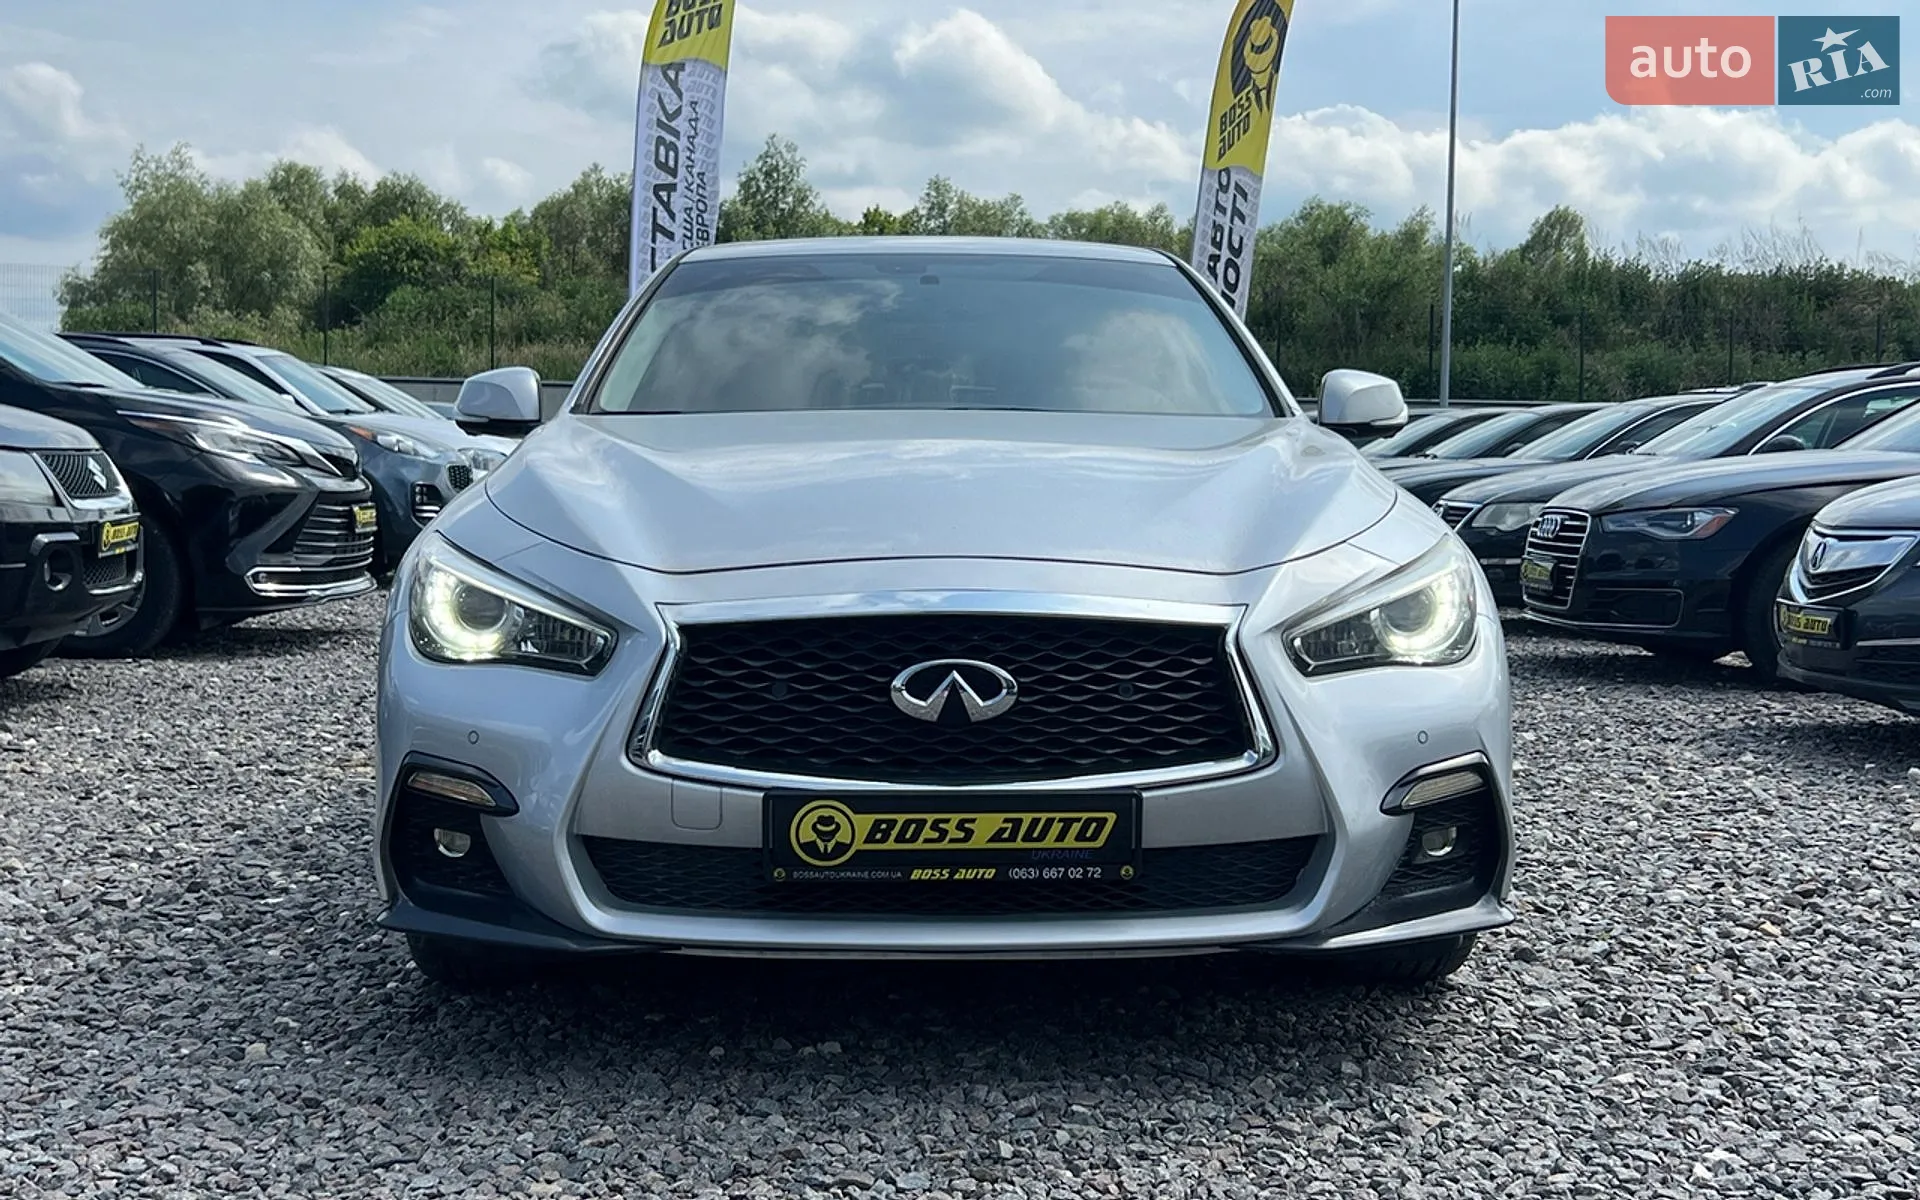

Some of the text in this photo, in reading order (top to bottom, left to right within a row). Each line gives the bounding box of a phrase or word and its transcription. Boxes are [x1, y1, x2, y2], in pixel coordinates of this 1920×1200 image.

[657, 3, 722, 48] AUTO
[1220, 88, 1253, 137] BOSS
[1217, 110, 1251, 163] AUTO
[862, 816, 1110, 845] BOSS AUTO
[1031, 849, 1094, 860] UKRAINE
[910, 868, 996, 881] BOSS AUTO
[1008, 867, 1102, 881] (063) 667 02 72
